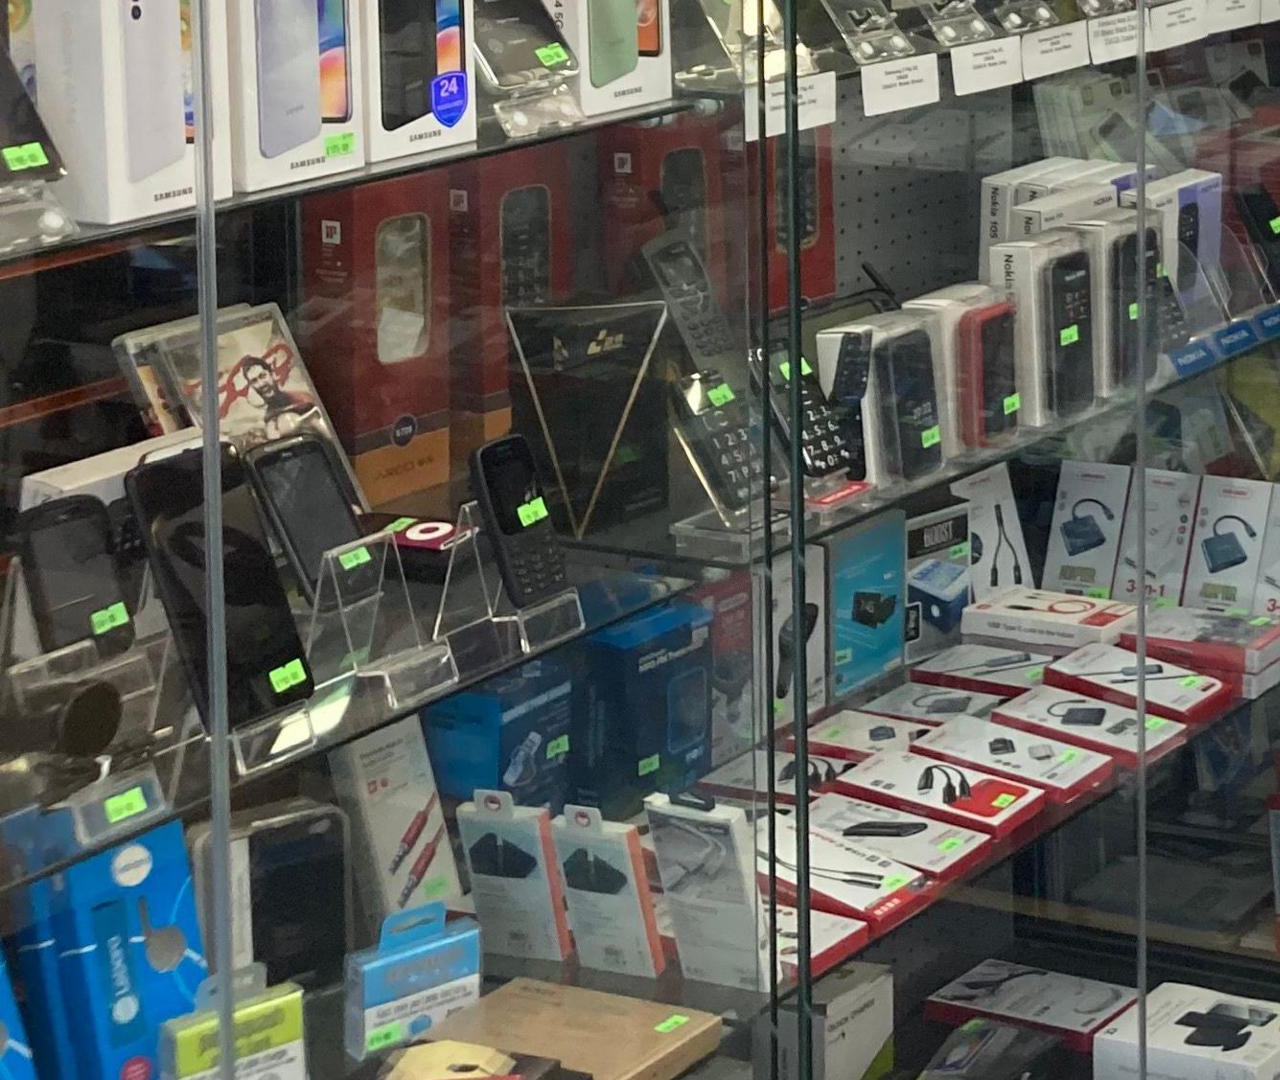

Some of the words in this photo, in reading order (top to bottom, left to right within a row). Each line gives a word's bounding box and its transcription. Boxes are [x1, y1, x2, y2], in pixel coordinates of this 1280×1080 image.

[439, 77, 459, 97] 24
[613, 86, 642, 98] SAMSUNG
[409, 129, 442, 143] SAMSUNG
[289, 156, 326, 170] SAMSUNG
[154, 186, 193, 203] SAMSUNG
[991, 187, 1000, 218] Nokia
[1220, 329, 1250, 346] NOKIA
[1177, 348, 1207, 367] NOKIA
